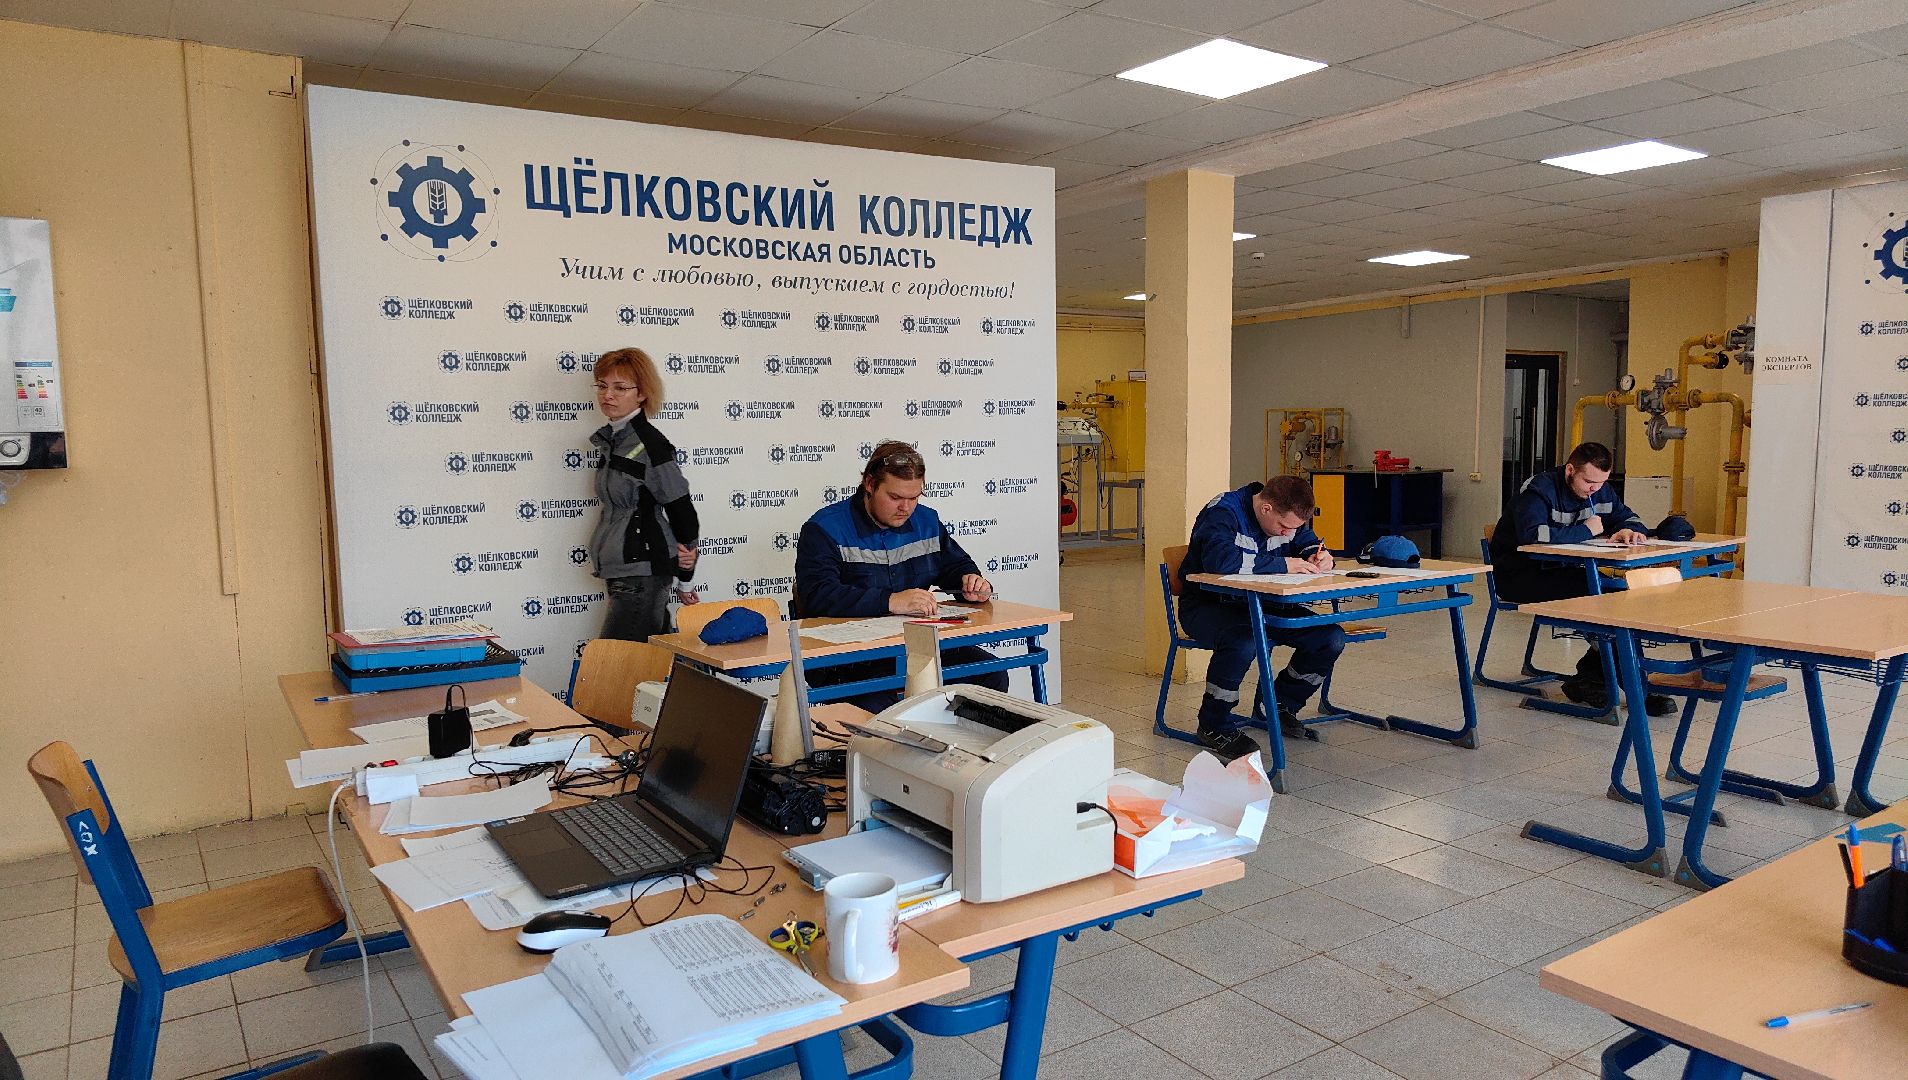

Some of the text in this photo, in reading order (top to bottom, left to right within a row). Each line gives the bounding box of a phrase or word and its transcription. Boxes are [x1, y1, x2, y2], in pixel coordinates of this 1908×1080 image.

[523, 157, 1033, 248] ЩЁЛКОВСКИЙ КОЛЛЕДЖ
[668, 232, 936, 269] МОСКОВСКАЯ ОБЛАСТЬ
[560, 258, 1015, 300] Учим с любовью, выпускаем с гордостью!
[408, 298, 472, 311] ЩЁЛКОВСКИЙ
[530, 302, 588, 314] ЩЁЛКОВСКИЙ
[408, 310, 455, 320] КОЛЛЕДЖ
[640, 306, 694, 317] ЩЁЛКОВСКИЙ
[741, 309, 791, 320] ЩЁЛКОВСКИЙ
[530, 313, 572, 323] КОЛЛЕДЖ
[640, 316, 679, 326] КОЛЛЕДЖ
[742, 319, 778, 328] КОЛЛЕДЖ
[1878, 320, 1908, 328] ЩЁЛКОВ
[465, 351, 527, 362] ЩЁЛКОВСКИЙ
[687, 355, 739, 365] ЩЁЛКОВСКИЙ
[466, 362, 510, 372] КОЛЛЕДЖ
[688, 364, 726, 373] КОЛЛЕДЖ
[1873, 392, 1908, 400] ЩЁЛКОВС
[415, 401, 479, 413] ЩЁЛКОВСКИЙ
[536, 401, 594, 412] ЩЁЛКОВСКИЙ
[746, 401, 795, 410] ЩЁЛКОВСКИЙ
[416, 412, 462, 423] КОЛЛЕДЖ
[536, 411, 578, 421] КОЛЛЕДЖ
[649, 411, 684, 420] ОЛЛЕДЖ
[746, 409, 782, 419] КОЛЛЕДЖ
[692, 446, 744, 456] ЩЁЛКОВСКИЙ
[472, 451, 533, 463] ЩЁЛКОВСКИЙ
[472, 462, 517, 472] КОЛЛЕДЖ
[1868, 464, 1908, 472] ЩЁЛКОВСК
[542, 497, 599, 510] ЩЁЛКОВСКИЙ
[751, 497, 785, 507] КОЛЛЕДЖ
[422, 502, 486, 516] ЩЁЛКОВСКИЙ
[542, 509, 583, 518] КОЛЛЕДЖ
[422, 513, 468, 524] КОЛЛЕДЖ
[478, 549, 538, 562] ЩЁЛКОВСКИЙ
[478, 559, 522, 571] КОЛЛЕДЖ
[547, 592, 604, 605] ЩЁЛКОВСКИЙ
[429, 602, 492, 616] ЩЁЛКОВСКИЙ
[548, 602, 589, 614] КОЛЛЕДЖ
